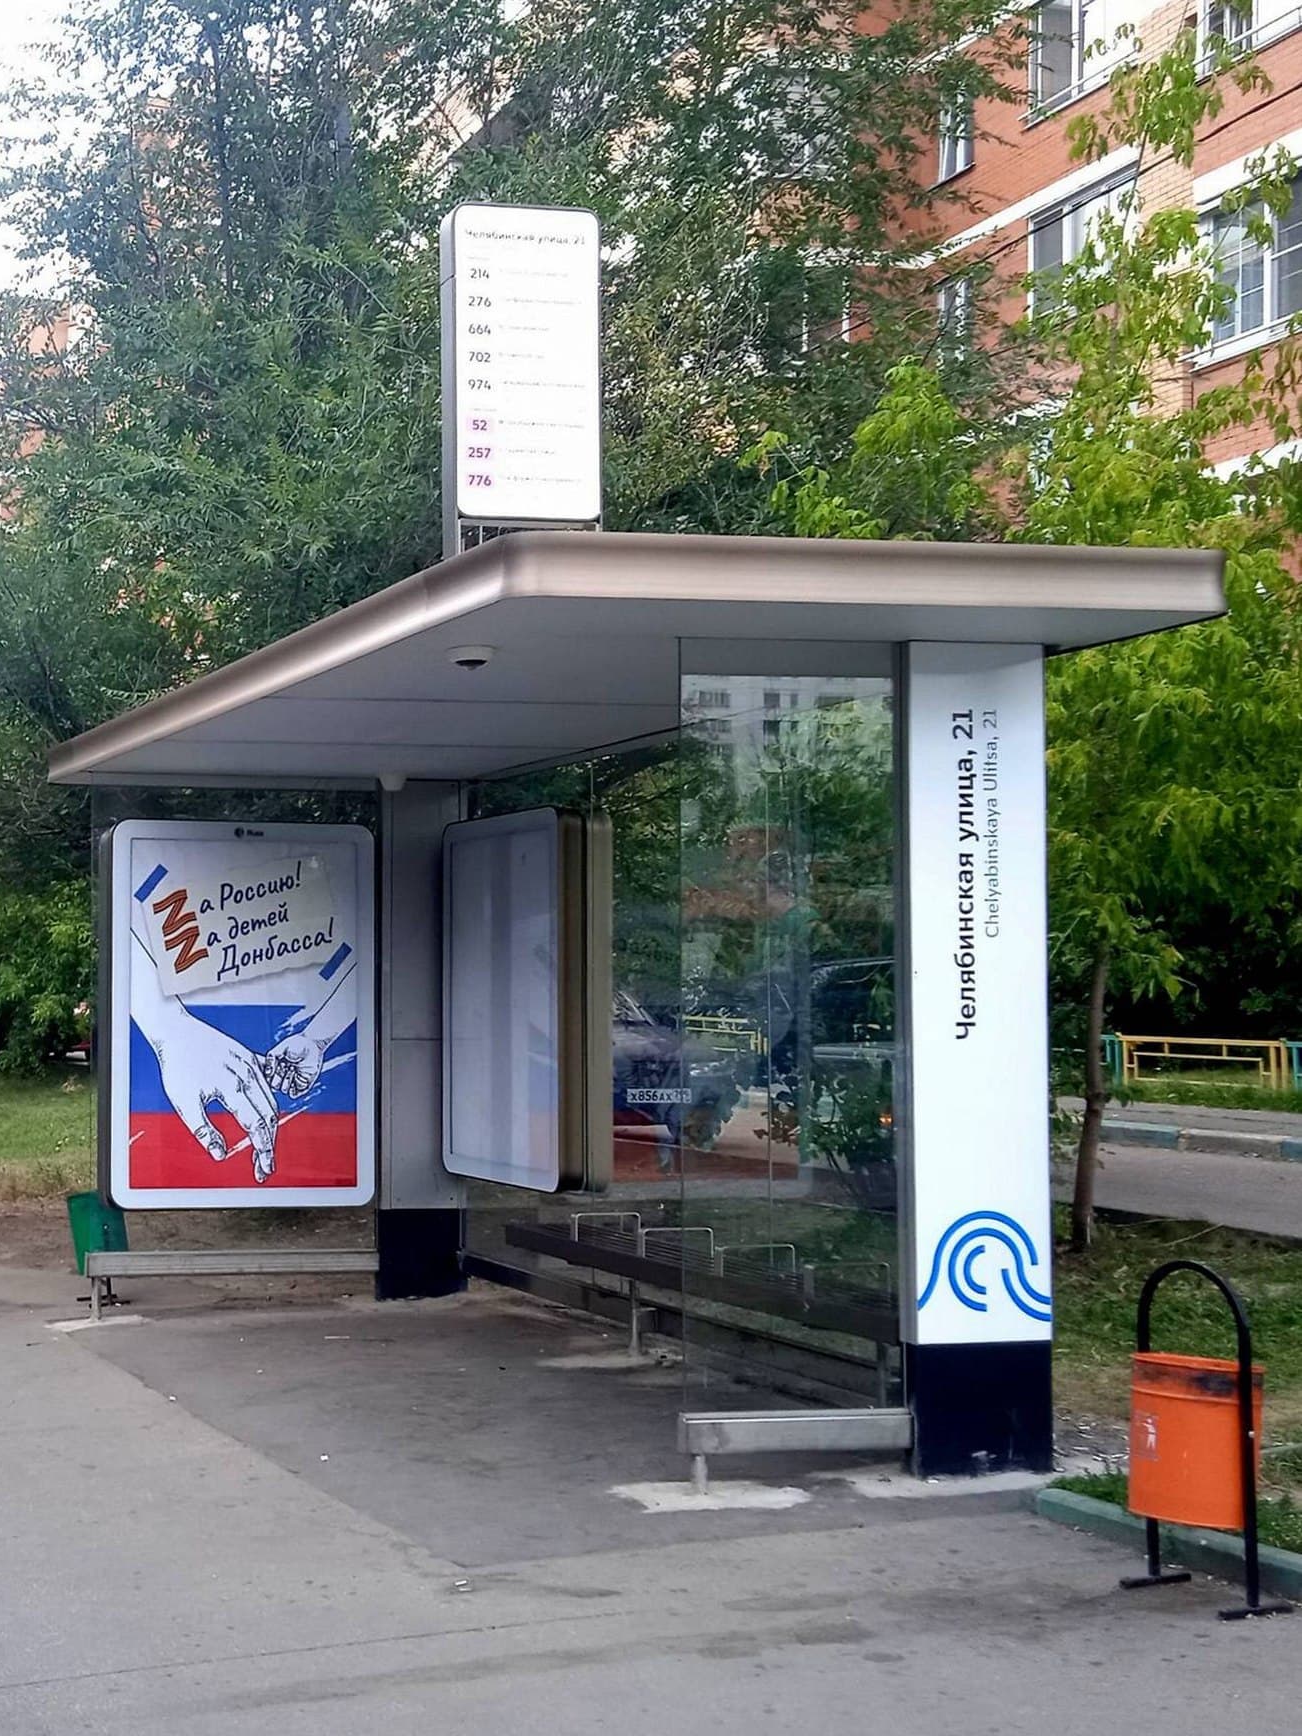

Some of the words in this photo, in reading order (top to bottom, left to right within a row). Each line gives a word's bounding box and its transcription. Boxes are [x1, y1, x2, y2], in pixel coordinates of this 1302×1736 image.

[469, 267, 490, 279] 214
[468, 295, 492, 308] 276
[468, 323, 491, 335] 664
[468, 351, 491, 363] 702
[467, 378, 491, 390] 974
[472, 419, 488, 431] 52
[467, 446, 491, 459] 257
[468, 474, 492, 487] 776
[952, 709, 973, 740] 21
[982, 709, 997, 729] 21
[982, 736, 1000, 791] Ulitsa,
[957, 750, 979, 842] улица,
[983, 798, 1002, 938] Chelyabinskaya
[220, 860, 302, 911] Россию!
[227, 902, 290, 940] детей
[217, 917, 334, 981] Донбасса!
[953, 853, 976, 1040] Челябинская
